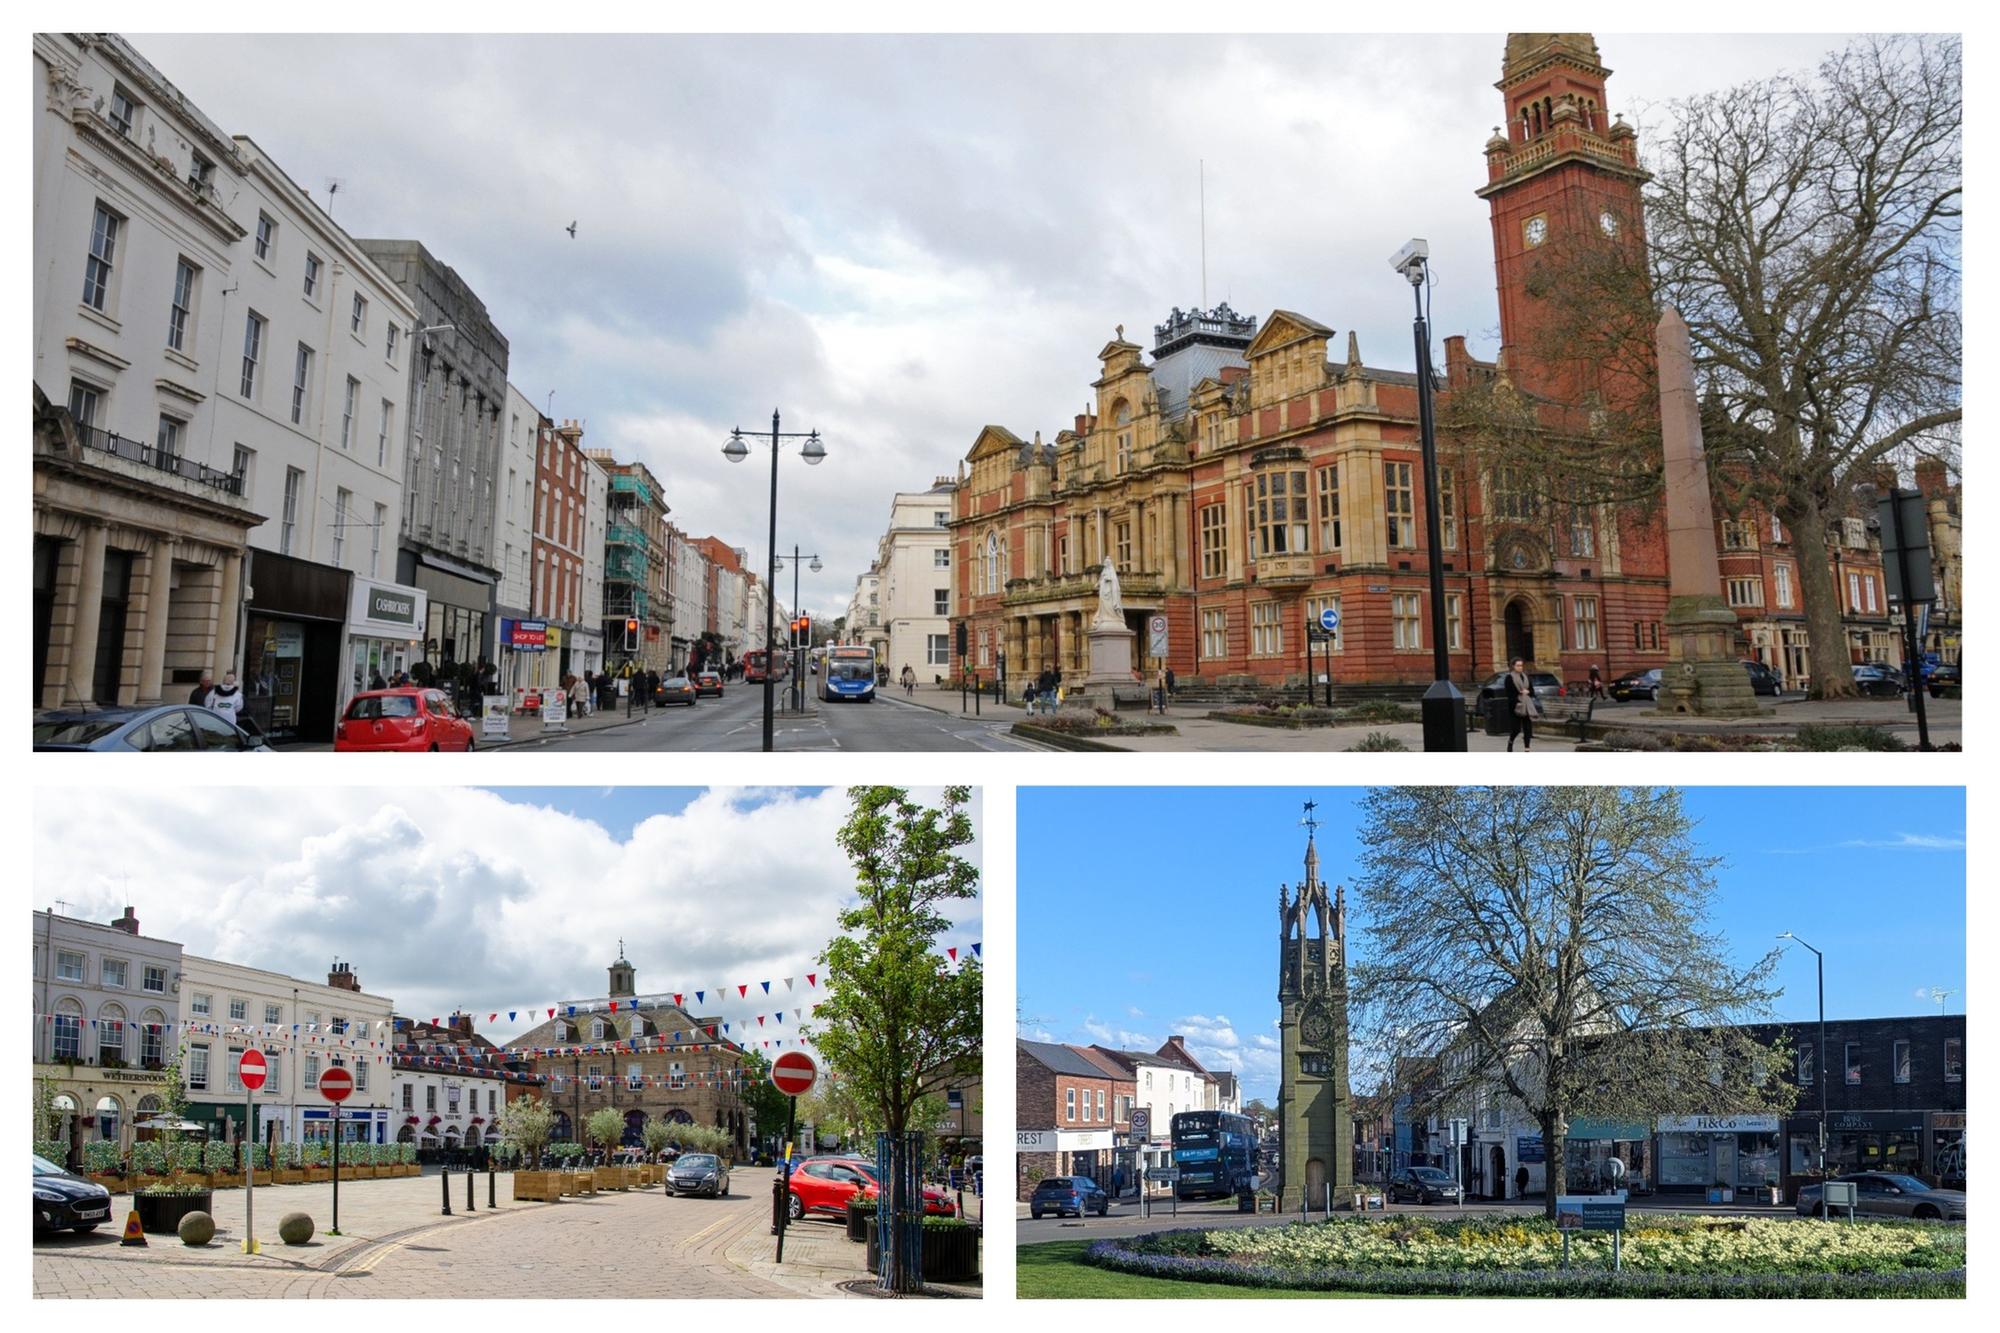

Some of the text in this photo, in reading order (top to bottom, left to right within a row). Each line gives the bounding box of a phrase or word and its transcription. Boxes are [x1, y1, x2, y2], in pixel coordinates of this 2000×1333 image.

[552, 1095, 643, 1103] MUSEUM
[928, 1121, 957, 1129] OSTA
[1697, 1117, 1736, 1129] H&Co
[1016, 1133, 1043, 1145] REST
